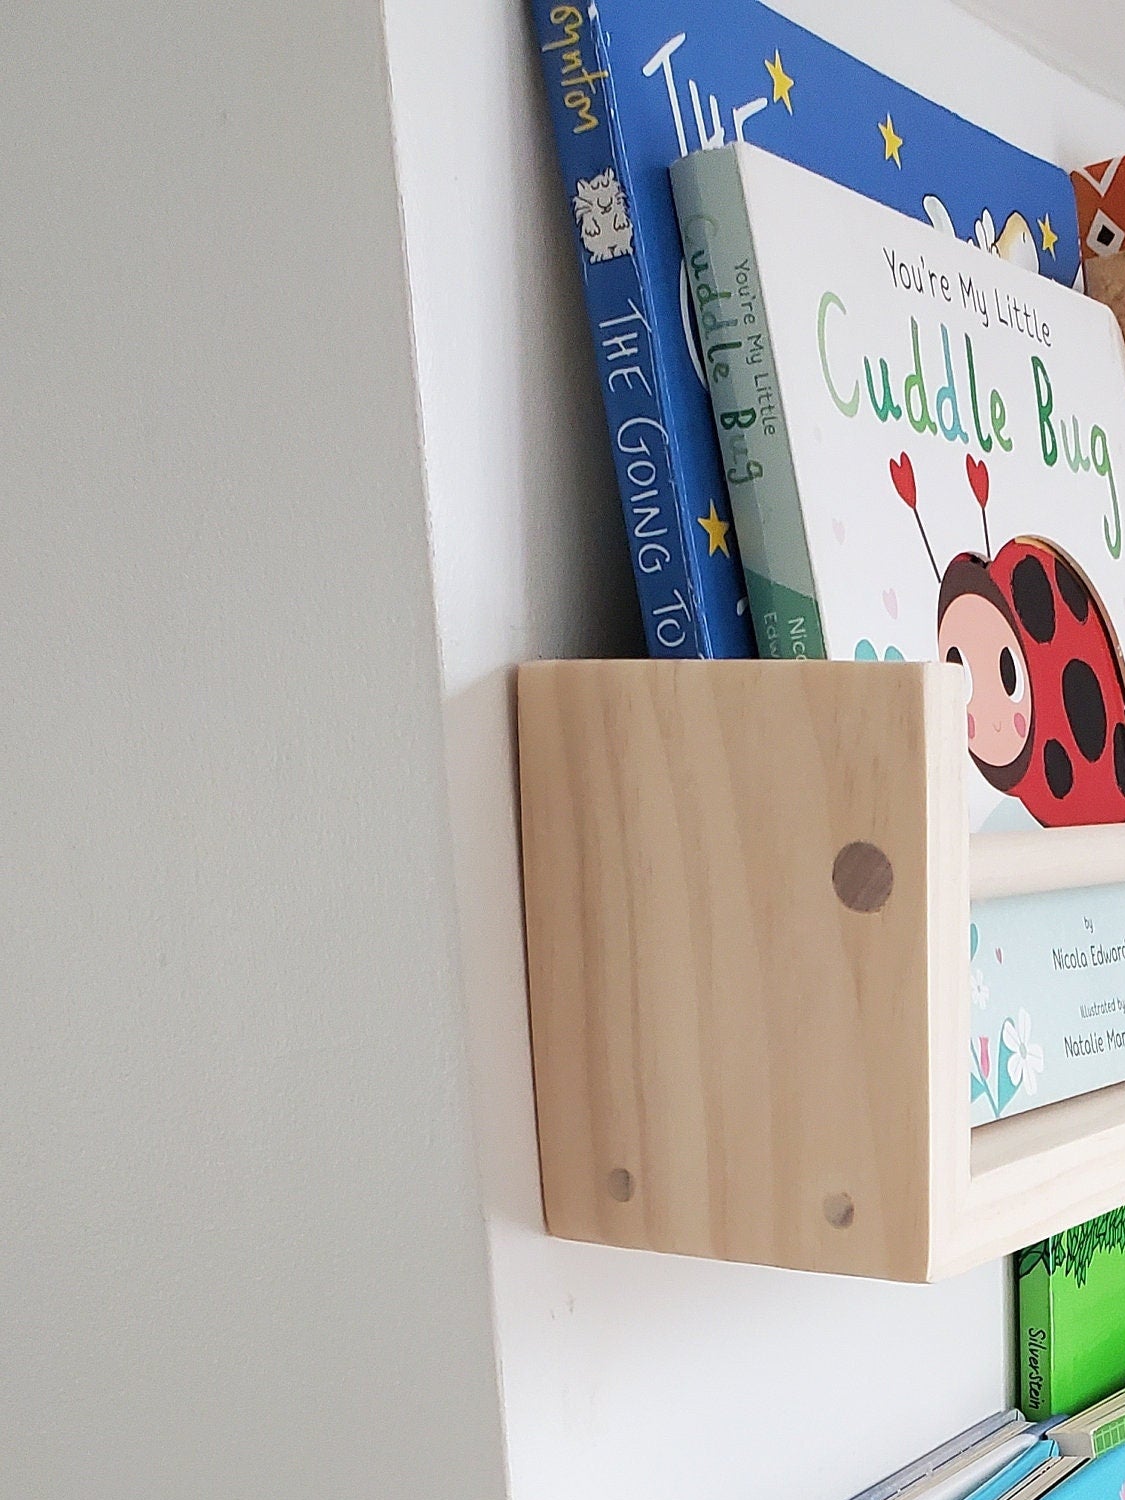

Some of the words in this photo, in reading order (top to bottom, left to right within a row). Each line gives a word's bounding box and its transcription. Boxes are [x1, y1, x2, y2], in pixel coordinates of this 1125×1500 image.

[733, 258, 756, 326] You're
[883, 246, 951, 303] You're
[958, 272, 990, 328] My
[994, 288, 1052, 347] Little
[599, 298, 652, 396] THE
[685, 214, 742, 384] Cuddle
[719, 406, 763, 485] Bug
[746, 333, 771, 366] My
[753, 372, 777, 437] Little
[817, 290, 1013, 453] Cuddle
[1031, 355, 1122, 560] Bug
[617, 417, 671, 574] GOING
[652, 588, 692, 648] TO
[1052, 946, 1088, 970] Nicola
[1084, 916, 1094, 934] by
[1080, 998, 1116, 1019] Illustrated
[1064, 1032, 1104, 1058] Natalie
[1028, 1327, 1047, 1410] Silverstein
